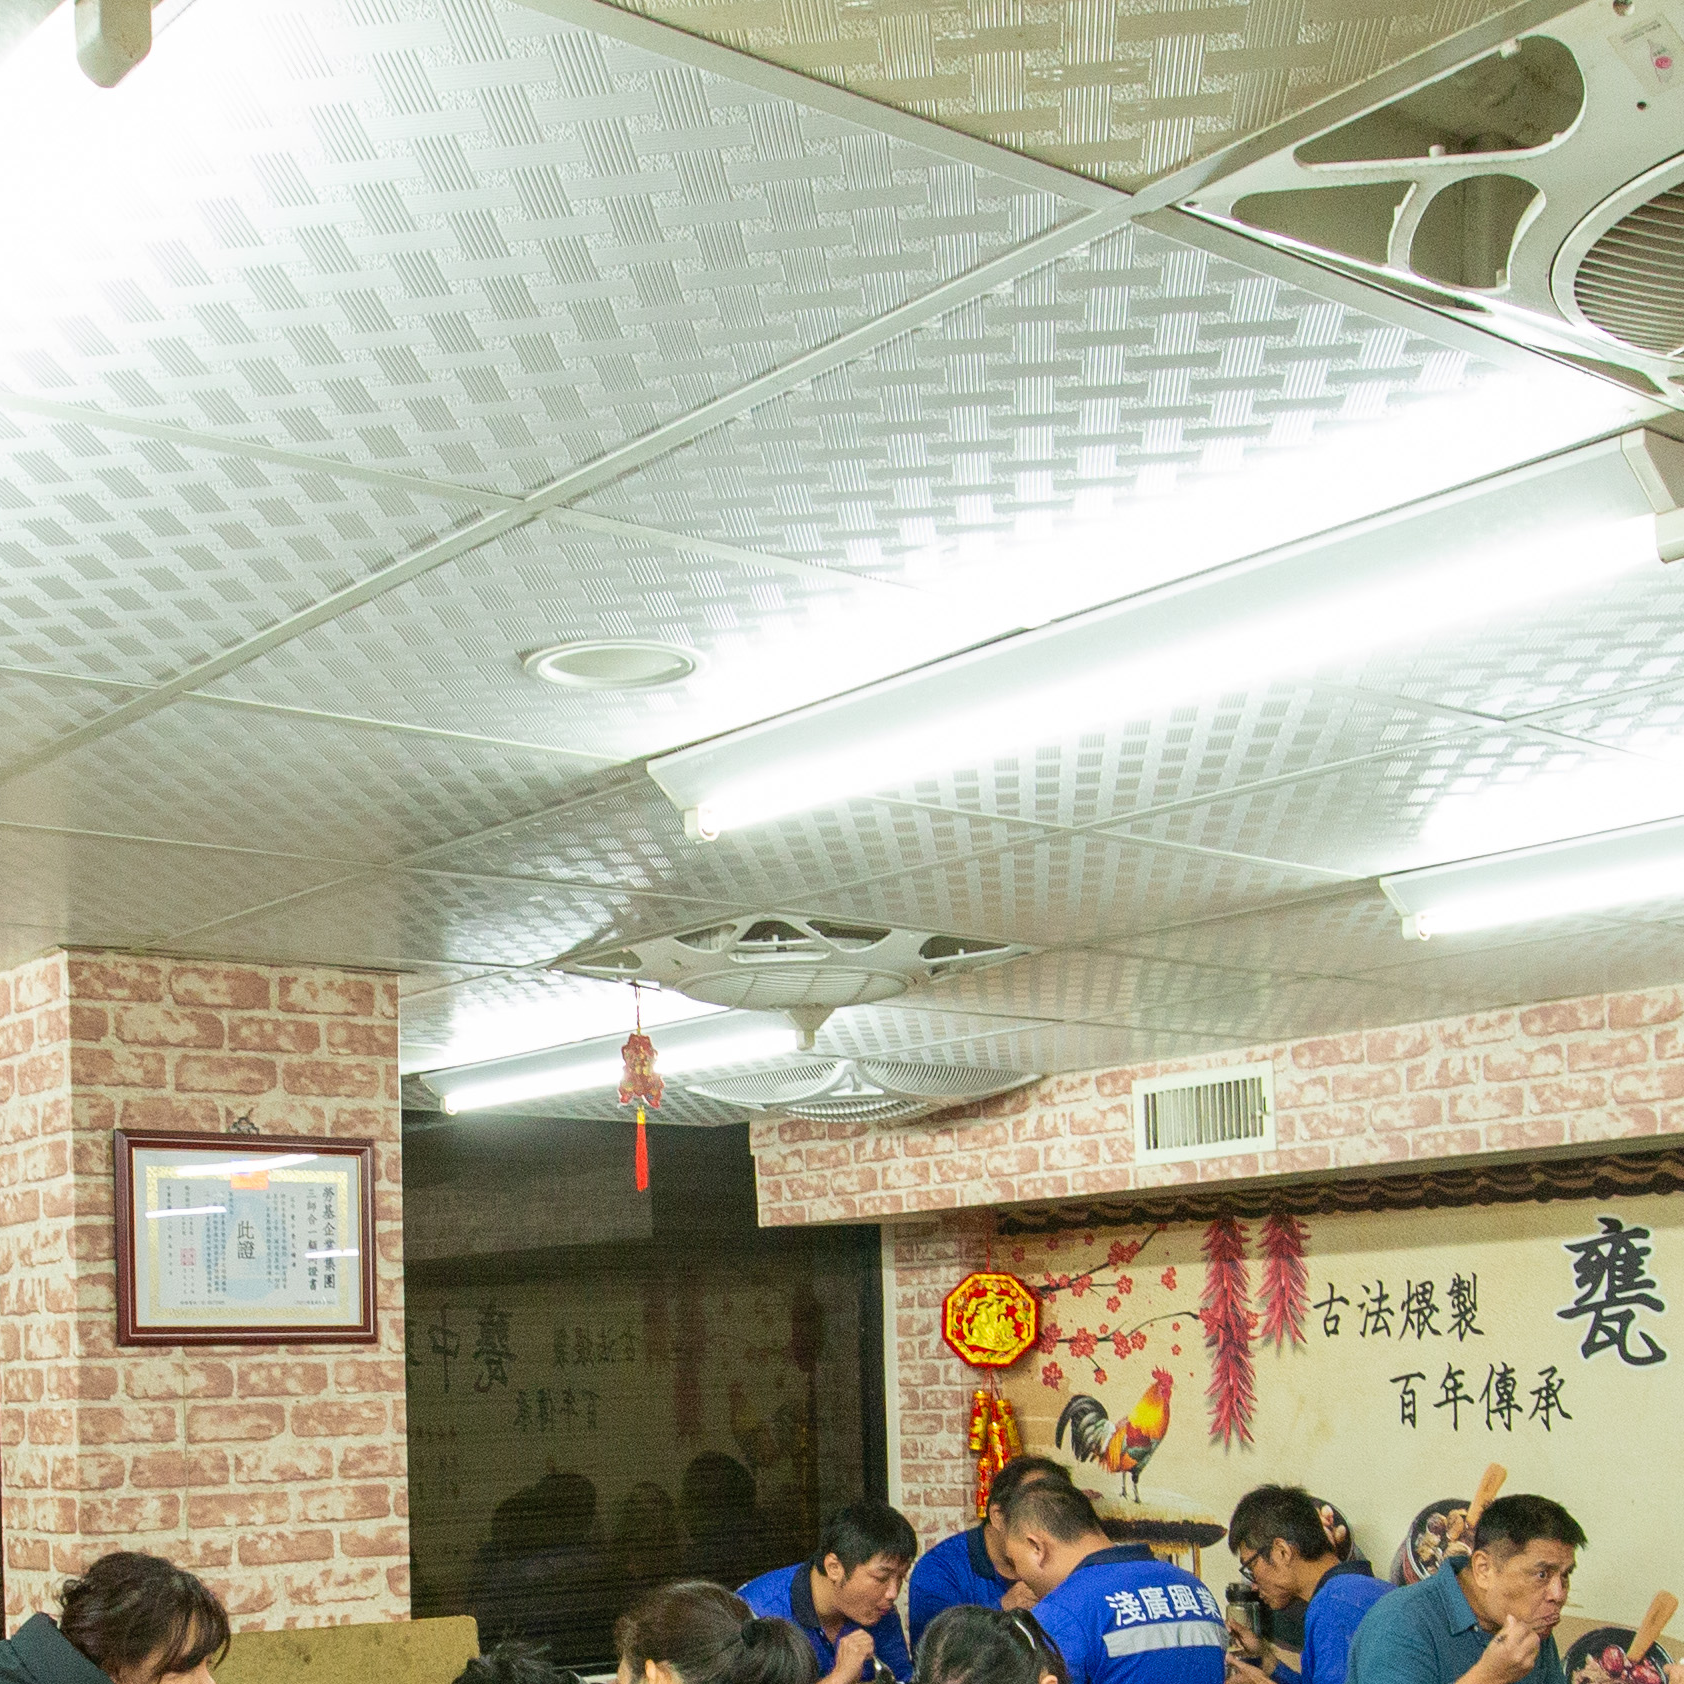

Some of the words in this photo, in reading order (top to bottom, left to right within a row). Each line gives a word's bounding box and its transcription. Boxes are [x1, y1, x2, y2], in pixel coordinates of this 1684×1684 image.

[1312, 1271, 1485, 1342] 古法煨製
[1389, 1361, 1573, 1432] 百年傳承
